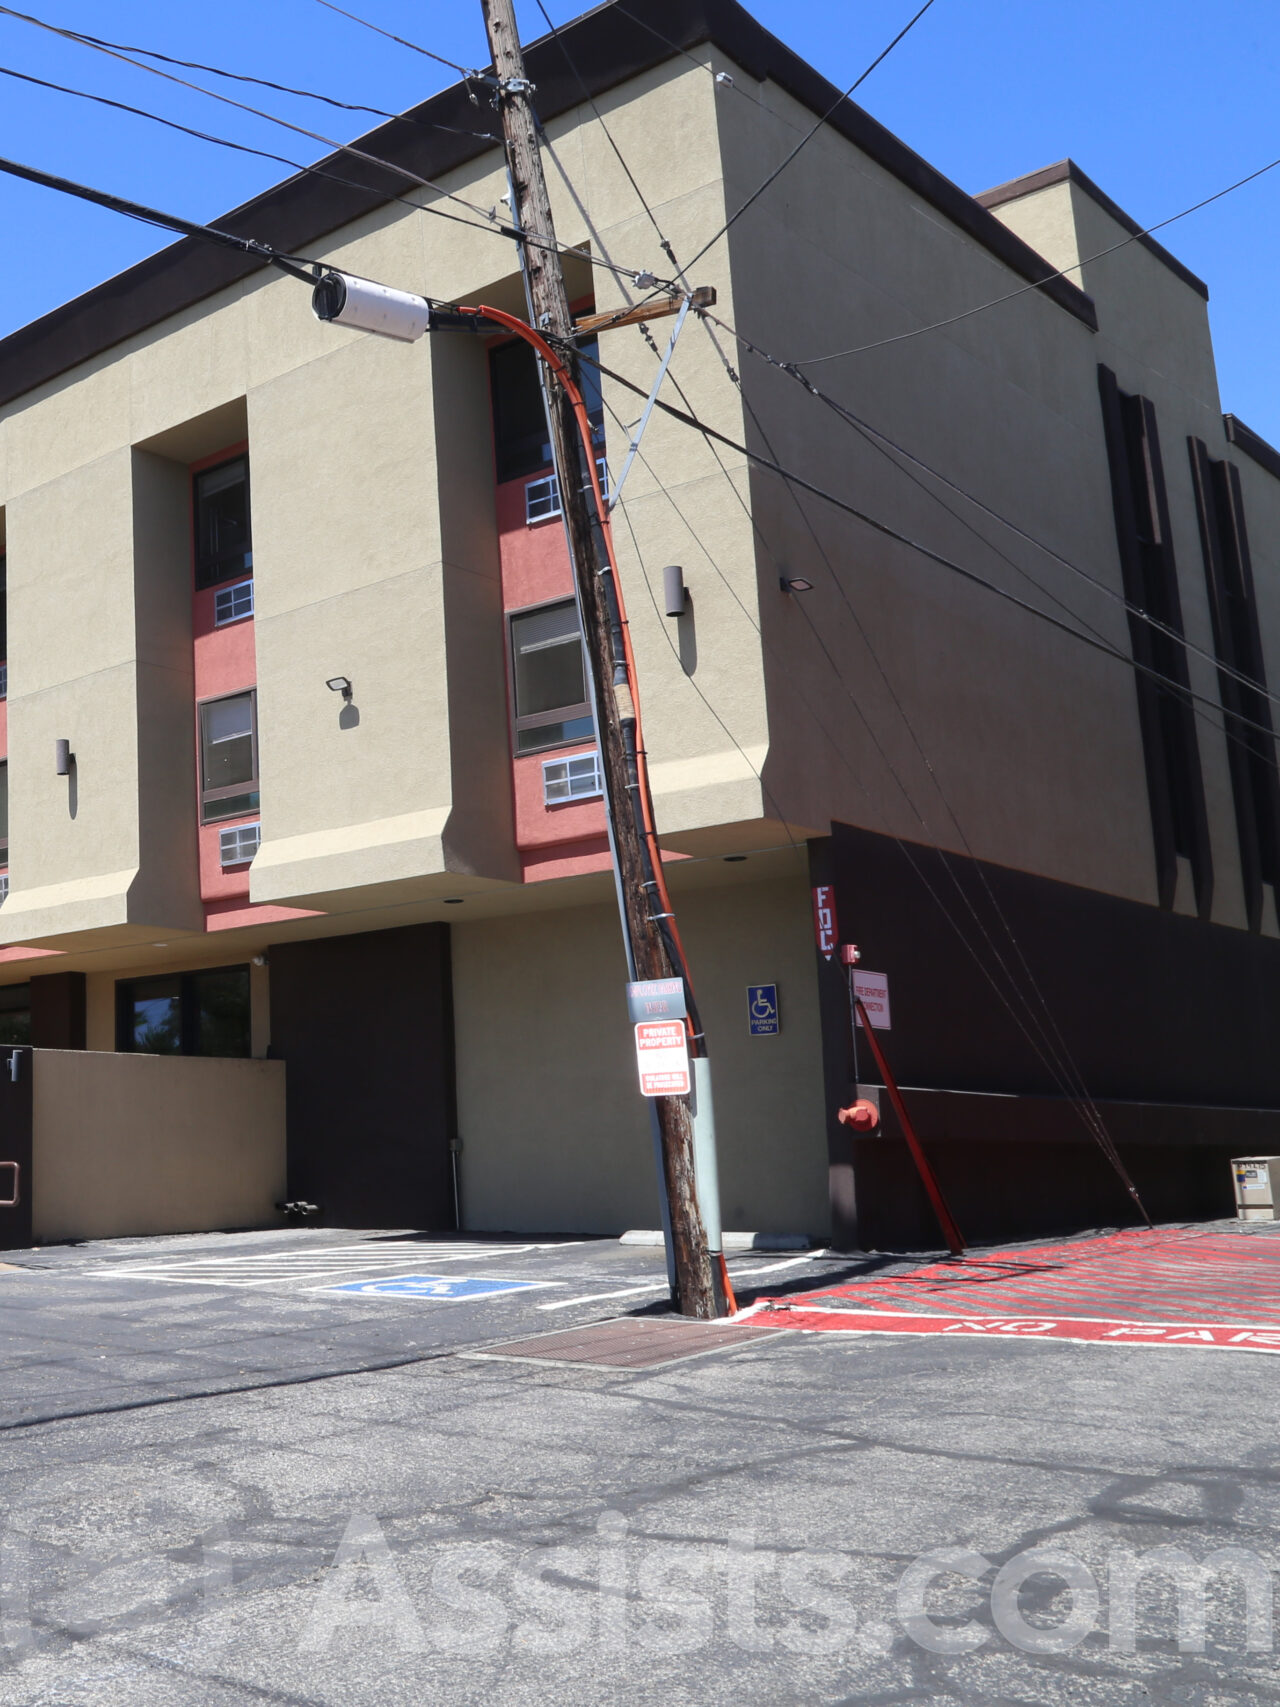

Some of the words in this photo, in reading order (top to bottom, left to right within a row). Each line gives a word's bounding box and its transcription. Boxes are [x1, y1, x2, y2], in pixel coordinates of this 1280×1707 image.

[816, 886, 834, 951] FDC
[643, 1027, 676, 1037] PRIVATE
[640, 1036, 682, 1048] PROPERTY
[942, 1320, 1057, 1332] NO
